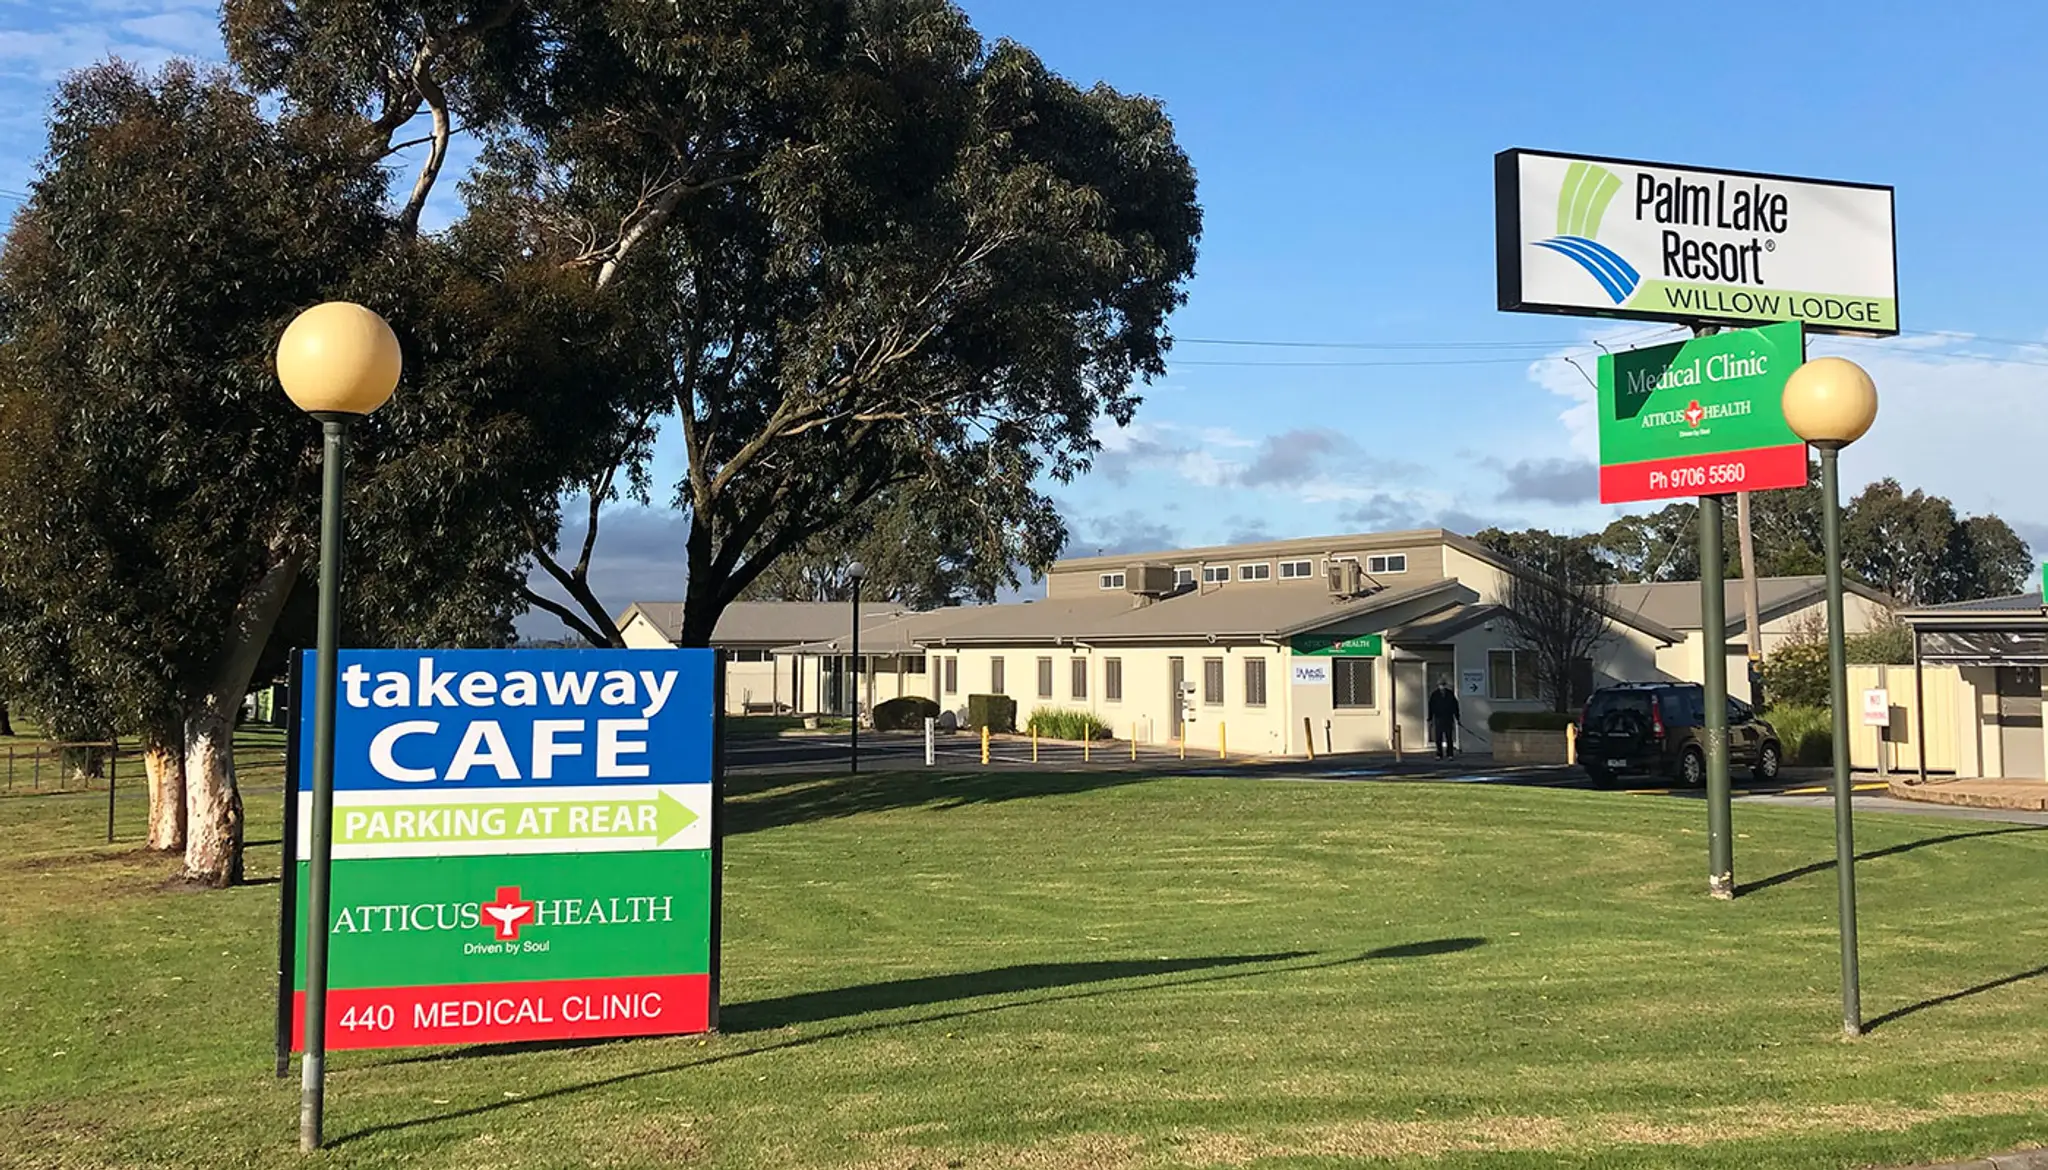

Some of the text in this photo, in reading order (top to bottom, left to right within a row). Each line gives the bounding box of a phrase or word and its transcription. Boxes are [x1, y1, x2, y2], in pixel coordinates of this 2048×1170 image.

[1635, 173, 1788, 234] Palm Lake
[1664, 287, 1882, 323] WILLOW LODGE
[1626, 350, 1768, 395] Medical Clinic
[1641, 400, 1751, 428] ATTICUS HEALTH
[1649, 463, 1745, 489] Ph 9706 5560
[341, 656, 679, 718] takeaway
[368, 717, 651, 783] CAFE
[345, 804, 658, 840] PARKING AT REAR
[331, 896, 673, 934] ATTICUS HEALTH
[463, 940, 550, 955] Driven by Soul
[339, 992, 662, 1031] 440 MEDICAL CLINIC
